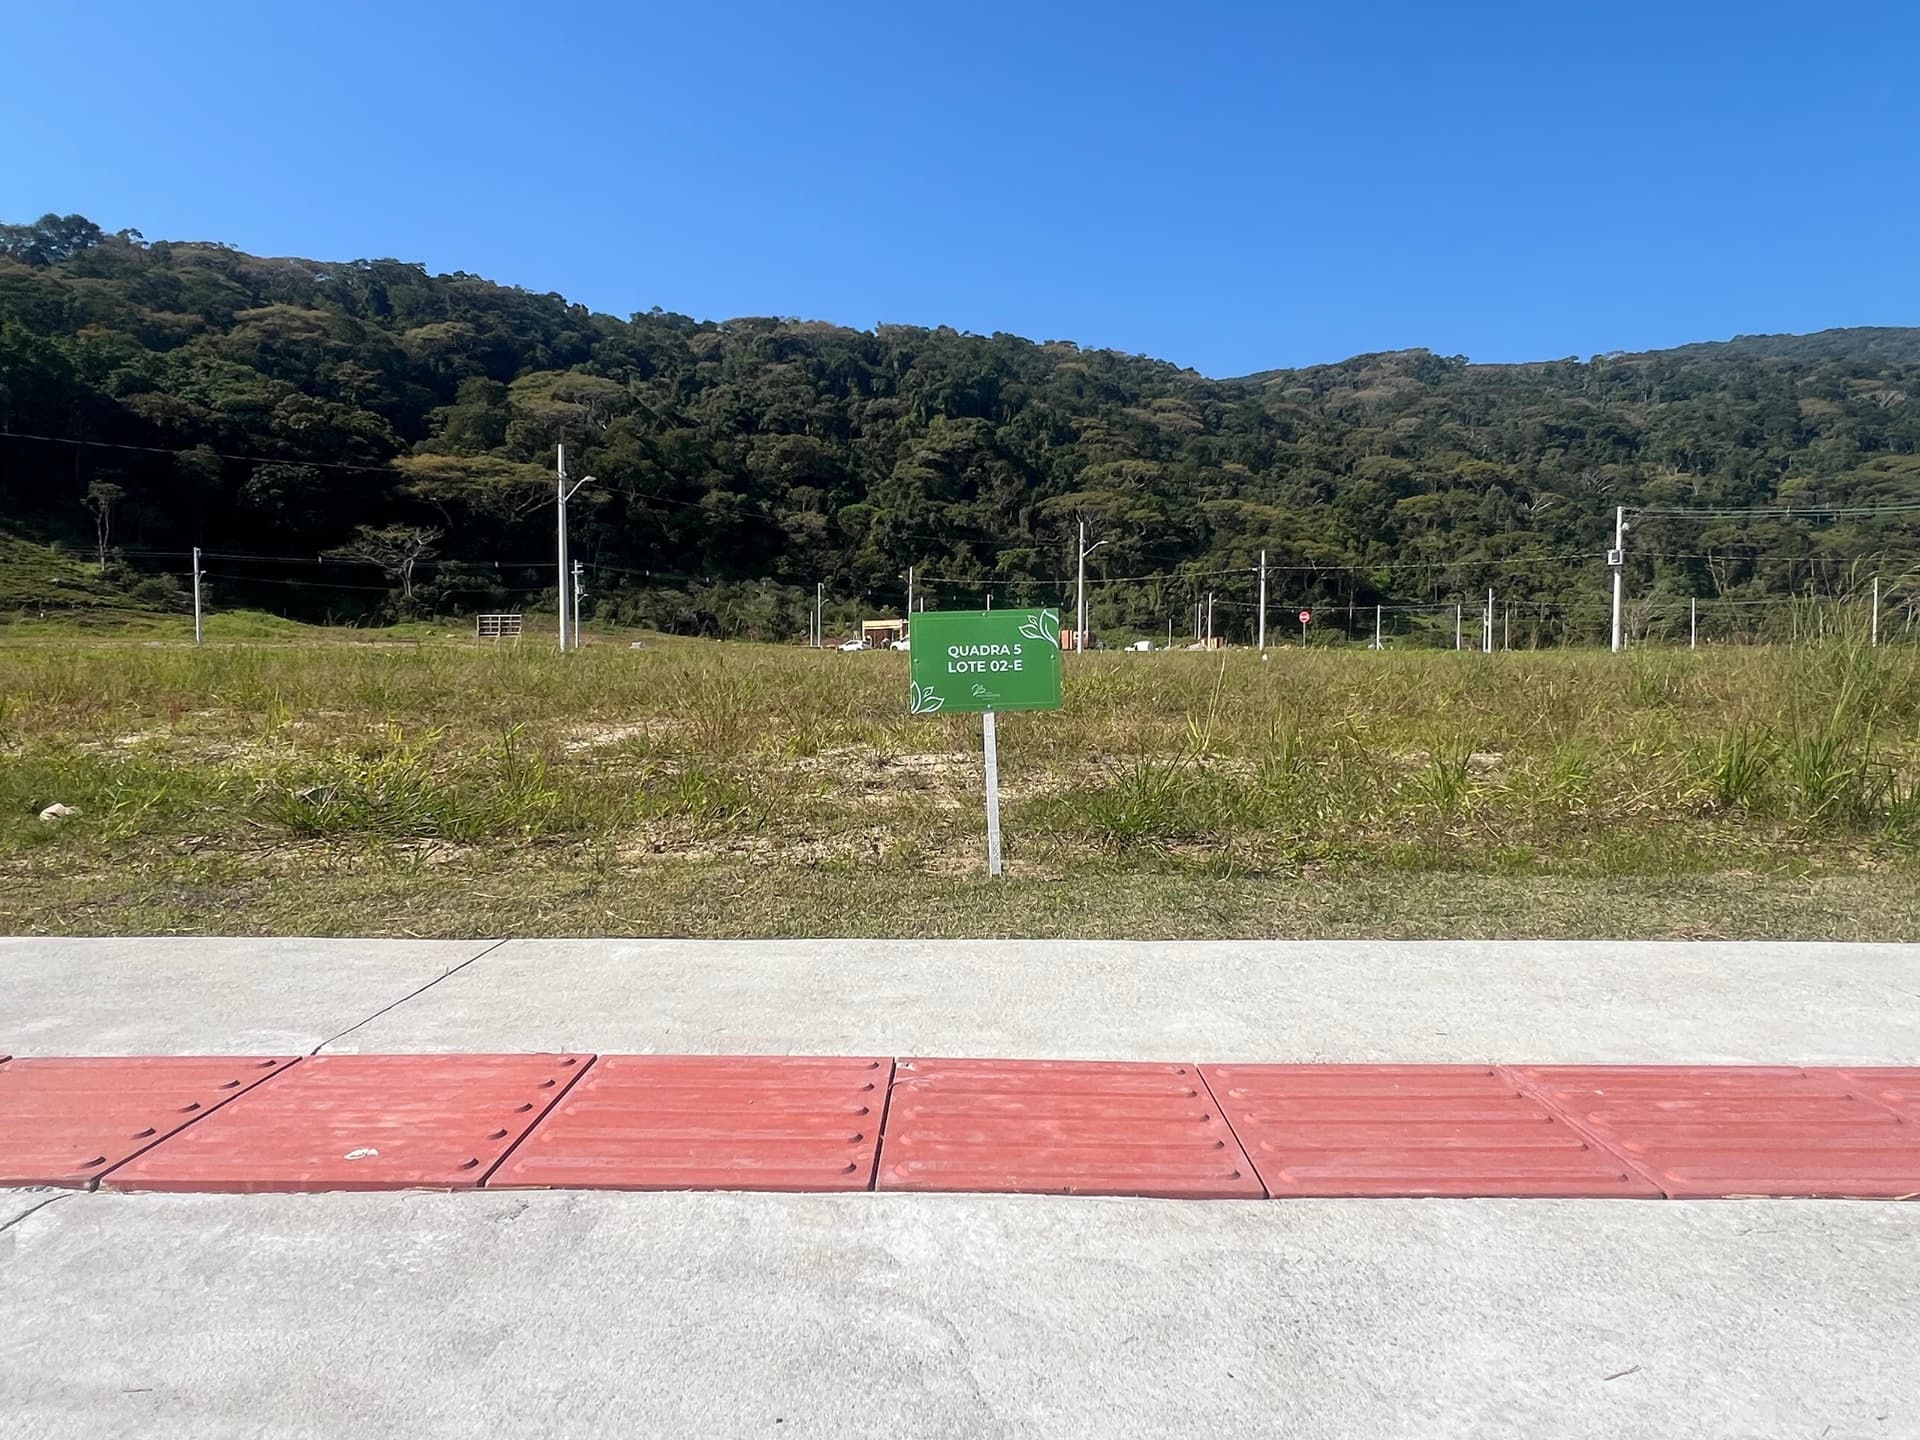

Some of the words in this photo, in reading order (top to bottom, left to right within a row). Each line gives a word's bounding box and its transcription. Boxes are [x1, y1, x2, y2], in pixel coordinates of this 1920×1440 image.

[947, 644, 1010, 658] QUADRA
[1014, 644, 1022, 654] 5
[948, 661, 986, 673] LOTE
[990, 660, 1022, 671] 02-E
